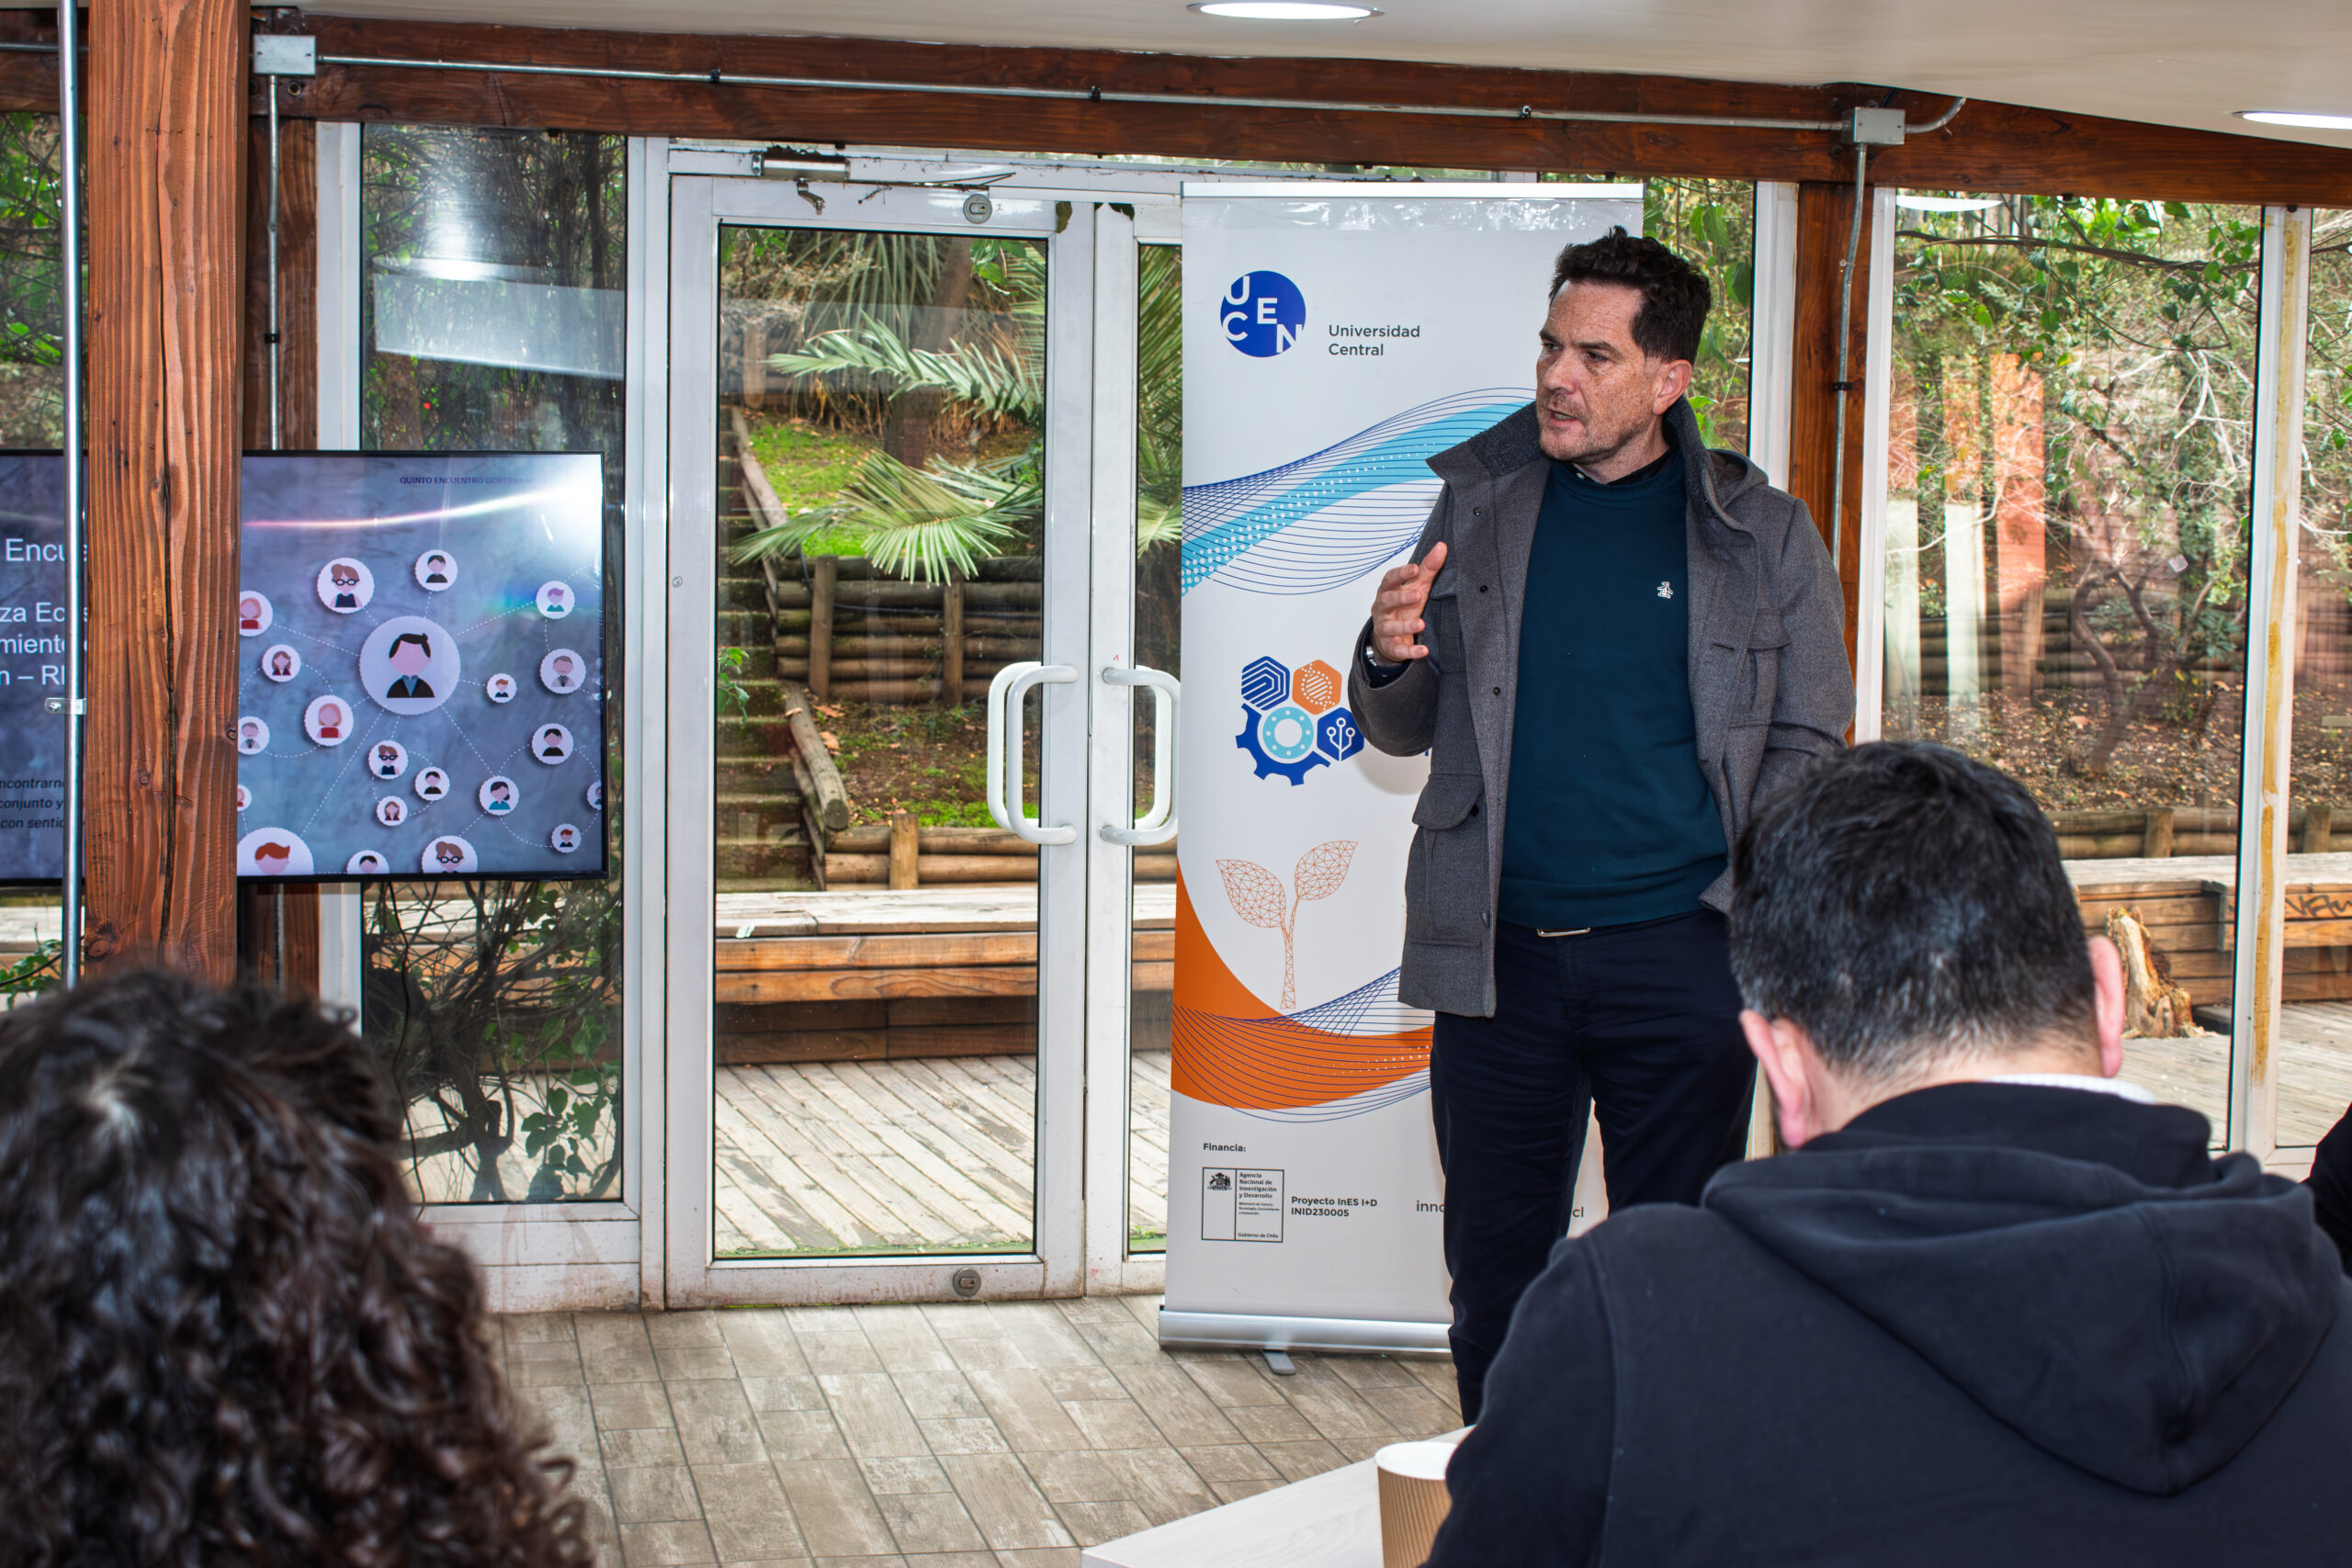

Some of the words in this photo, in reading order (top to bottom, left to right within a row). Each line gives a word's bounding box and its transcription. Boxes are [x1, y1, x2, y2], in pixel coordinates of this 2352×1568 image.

[1329, 324, 1420, 338] Universidad
[1329, 343, 1385, 356] Central
[399, 477, 433, 485] QUINTO
[435, 477, 483, 485] ENCUENTRO
[485, 477, 546, 485] GOBERNAN
[1203, 1143, 1247, 1153] Financia:
[1291, 1196, 1335, 1206] Proyecto
[1338, 1198, 1360, 1206] InES
[1362, 1198, 1378, 1207] I+D
[1291, 1207, 1350, 1217] INID230005
